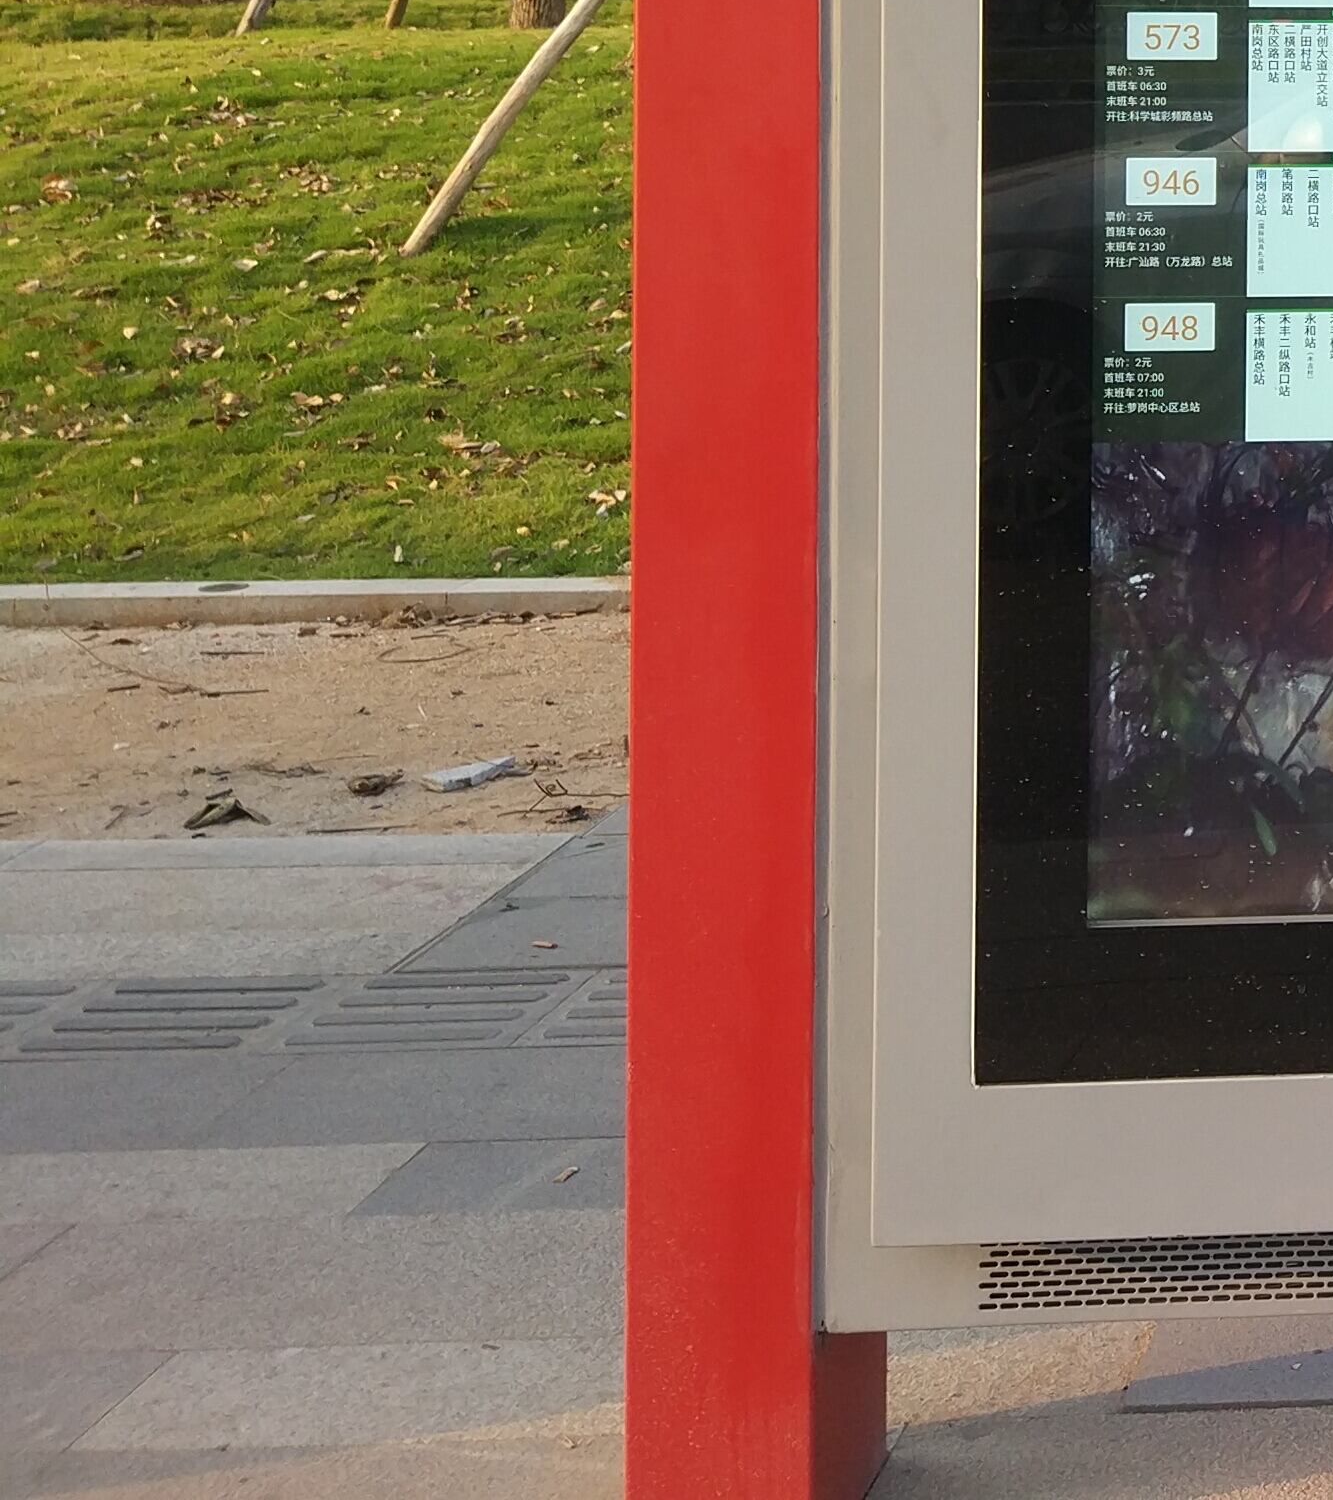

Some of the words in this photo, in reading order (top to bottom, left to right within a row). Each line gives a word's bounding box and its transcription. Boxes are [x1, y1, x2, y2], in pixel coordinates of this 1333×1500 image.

[1145, 24, 1200, 50] 573
[1106, 81, 1137, 91] 首班车
[1140, 82, 1166, 91] 06:30
[1106, 96, 1137, 106] 末班车
[1140, 97, 1166, 106] 21:00
[1143, 170, 1200, 195] 946
[1105, 227, 1136, 237] 首班车
[1138, 228, 1166, 236] 06:30
[1105, 242, 1136, 252] 末班车
[1138, 243, 1166, 252] 21:30
[1142, 316, 1198, 340] 948
[1104, 373, 1135, 383] 首班车
[1138, 373, 1164, 382] 07:00
[1104, 388, 1135, 398] 末班车
[1137, 388, 1164, 397] 21:00
